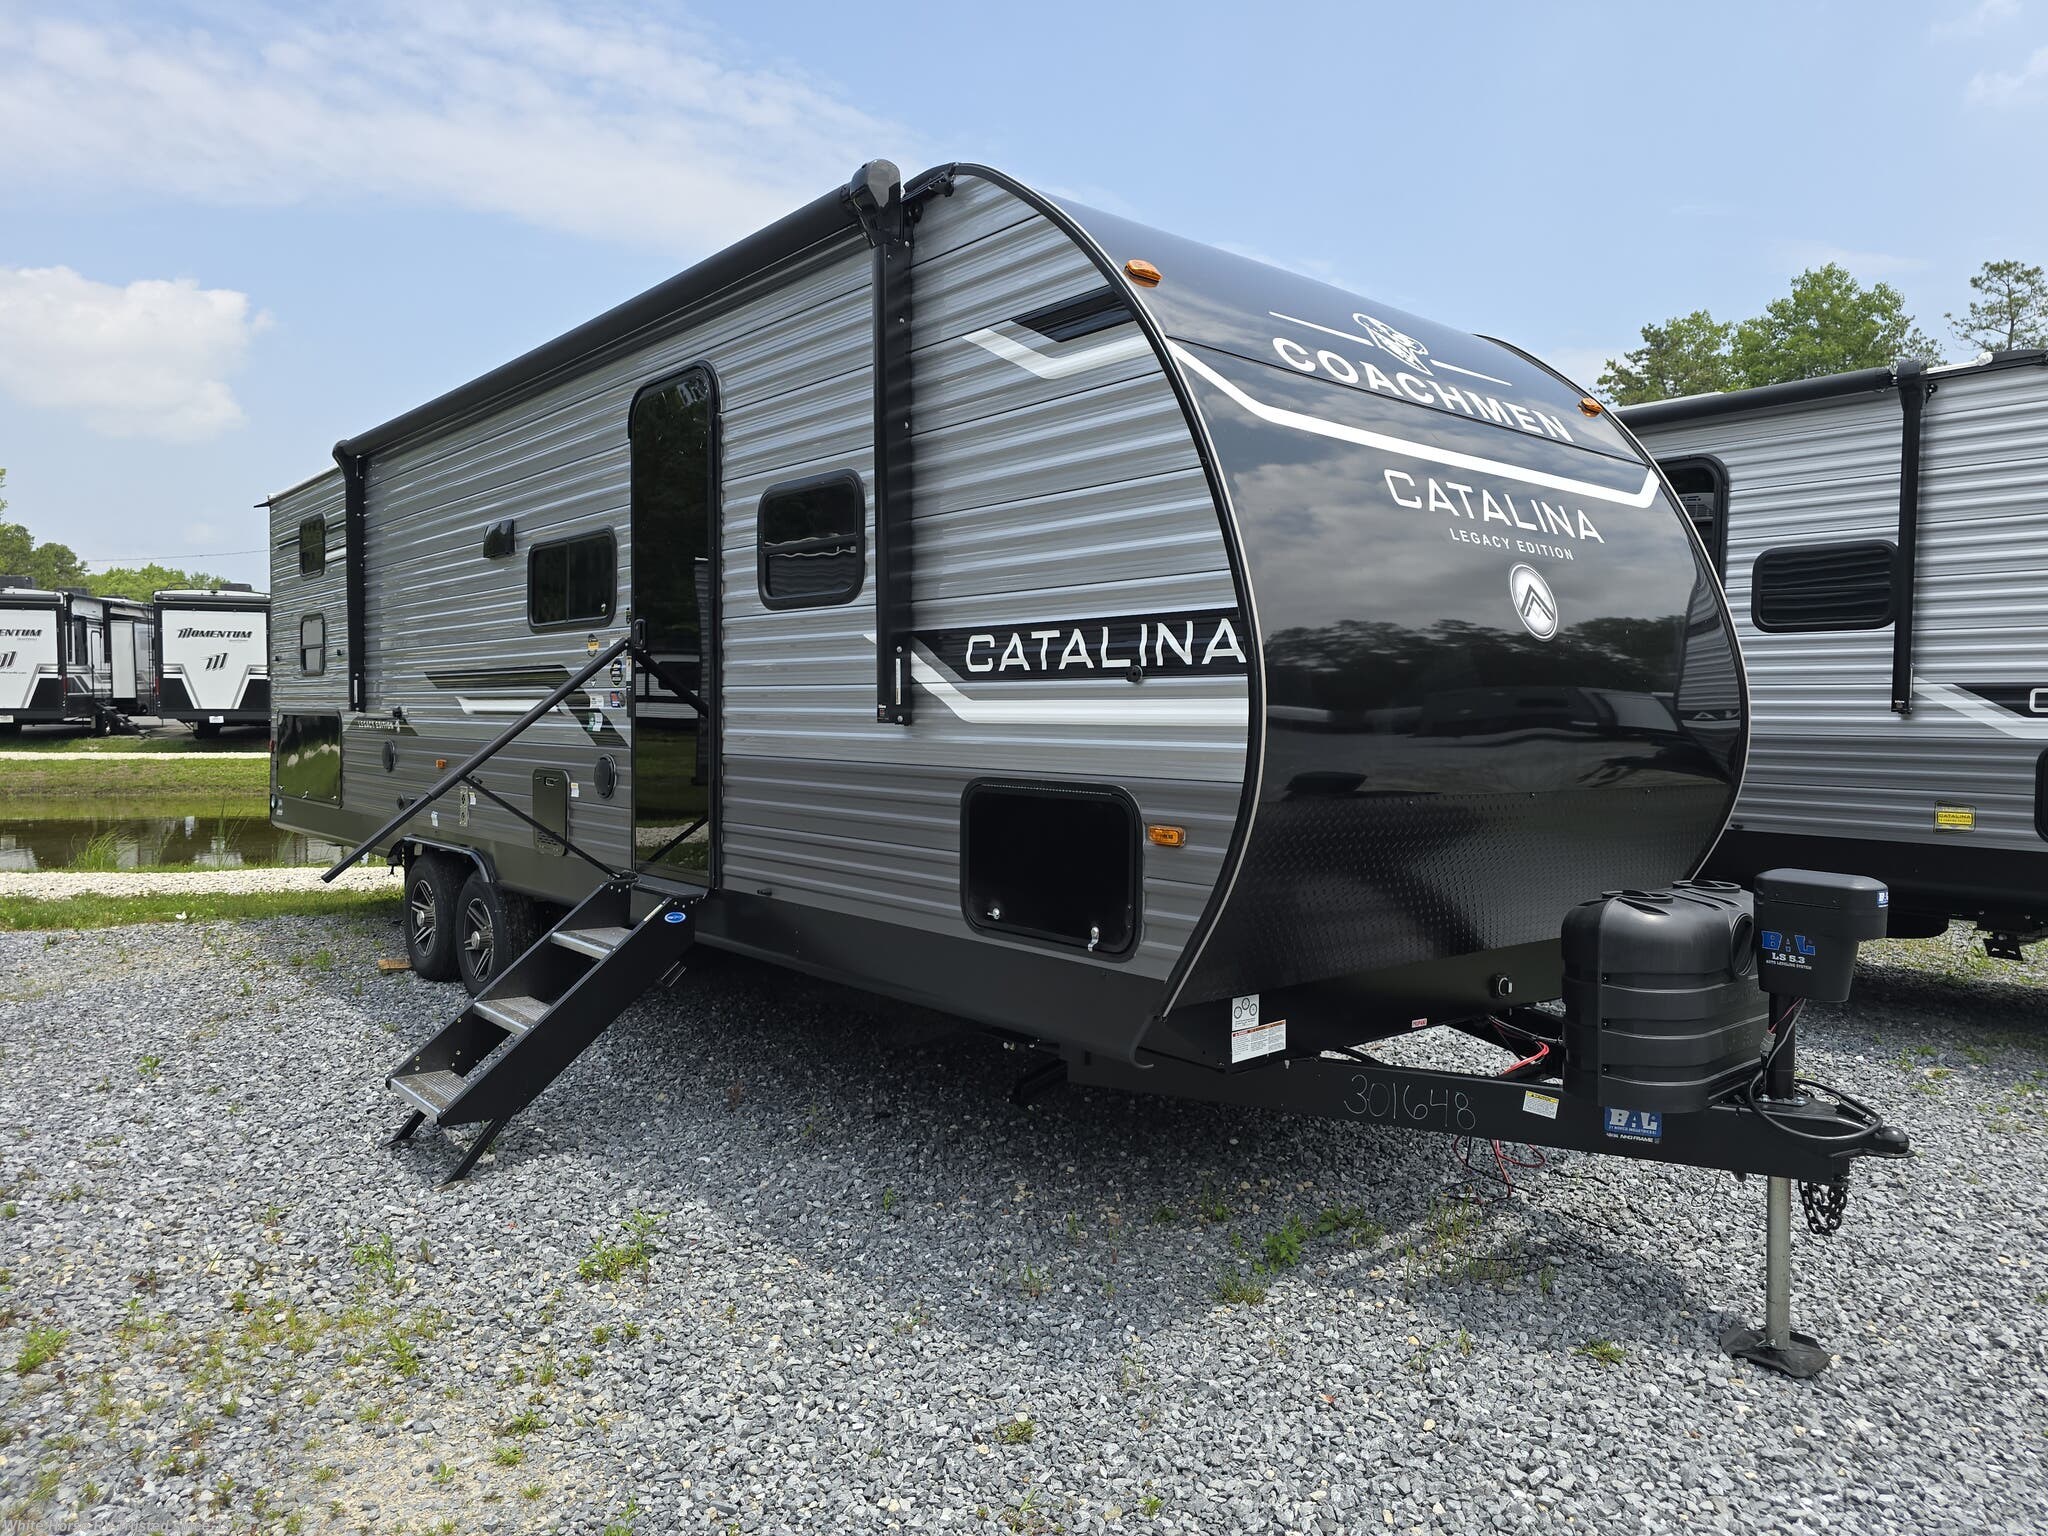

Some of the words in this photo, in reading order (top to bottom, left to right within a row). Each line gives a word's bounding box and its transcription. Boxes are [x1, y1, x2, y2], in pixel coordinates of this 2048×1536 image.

[1272, 337, 1574, 442] COACHMEN
[1383, 468, 1605, 544] CATALINA
[1449, 527, 1510, 550] LEGACY
[1516, 540, 1574, 561] EDITION
[964, 617, 1248, 673] CATALINA
[1761, 930, 1816, 956] BAL
[1771, 952, 1787, 961] LS
[1343, 1074, 1476, 1130] 301648
[1609, 1108, 1658, 1131] BAL
